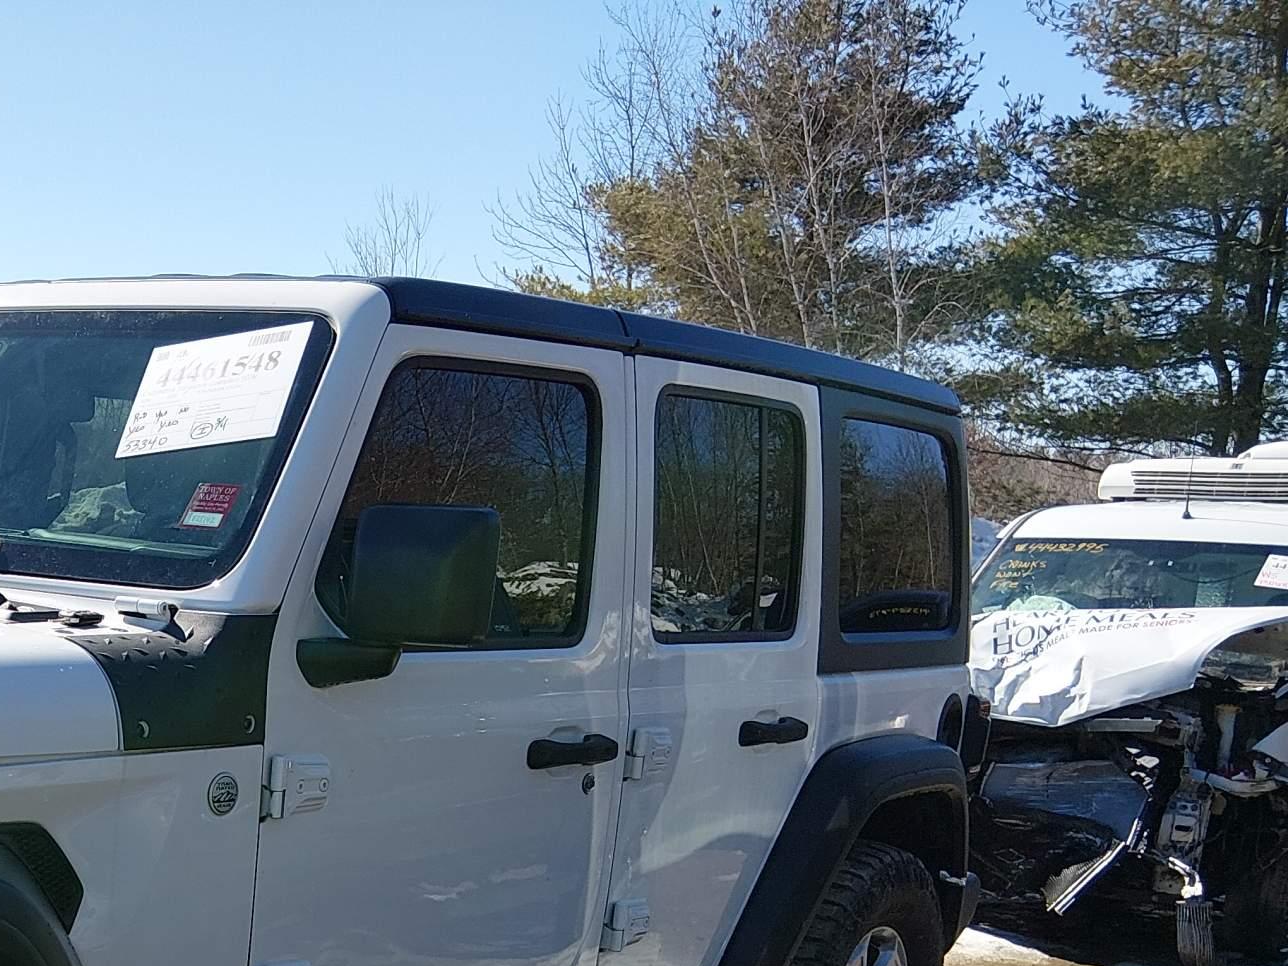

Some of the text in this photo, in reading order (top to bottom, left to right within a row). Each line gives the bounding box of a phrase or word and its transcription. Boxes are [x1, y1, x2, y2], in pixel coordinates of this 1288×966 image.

[157, 350, 282, 388] 44461548
[198, 493, 231, 502] NAPLES
[200, 486, 238, 495] TOWN OF
[1078, 624, 1113, 635] MADE
[1116, 622, 1140, 632] FOR
[1142, 617, 1193, 629] SENIORS
[1085, 611, 1196, 626] MEALS
